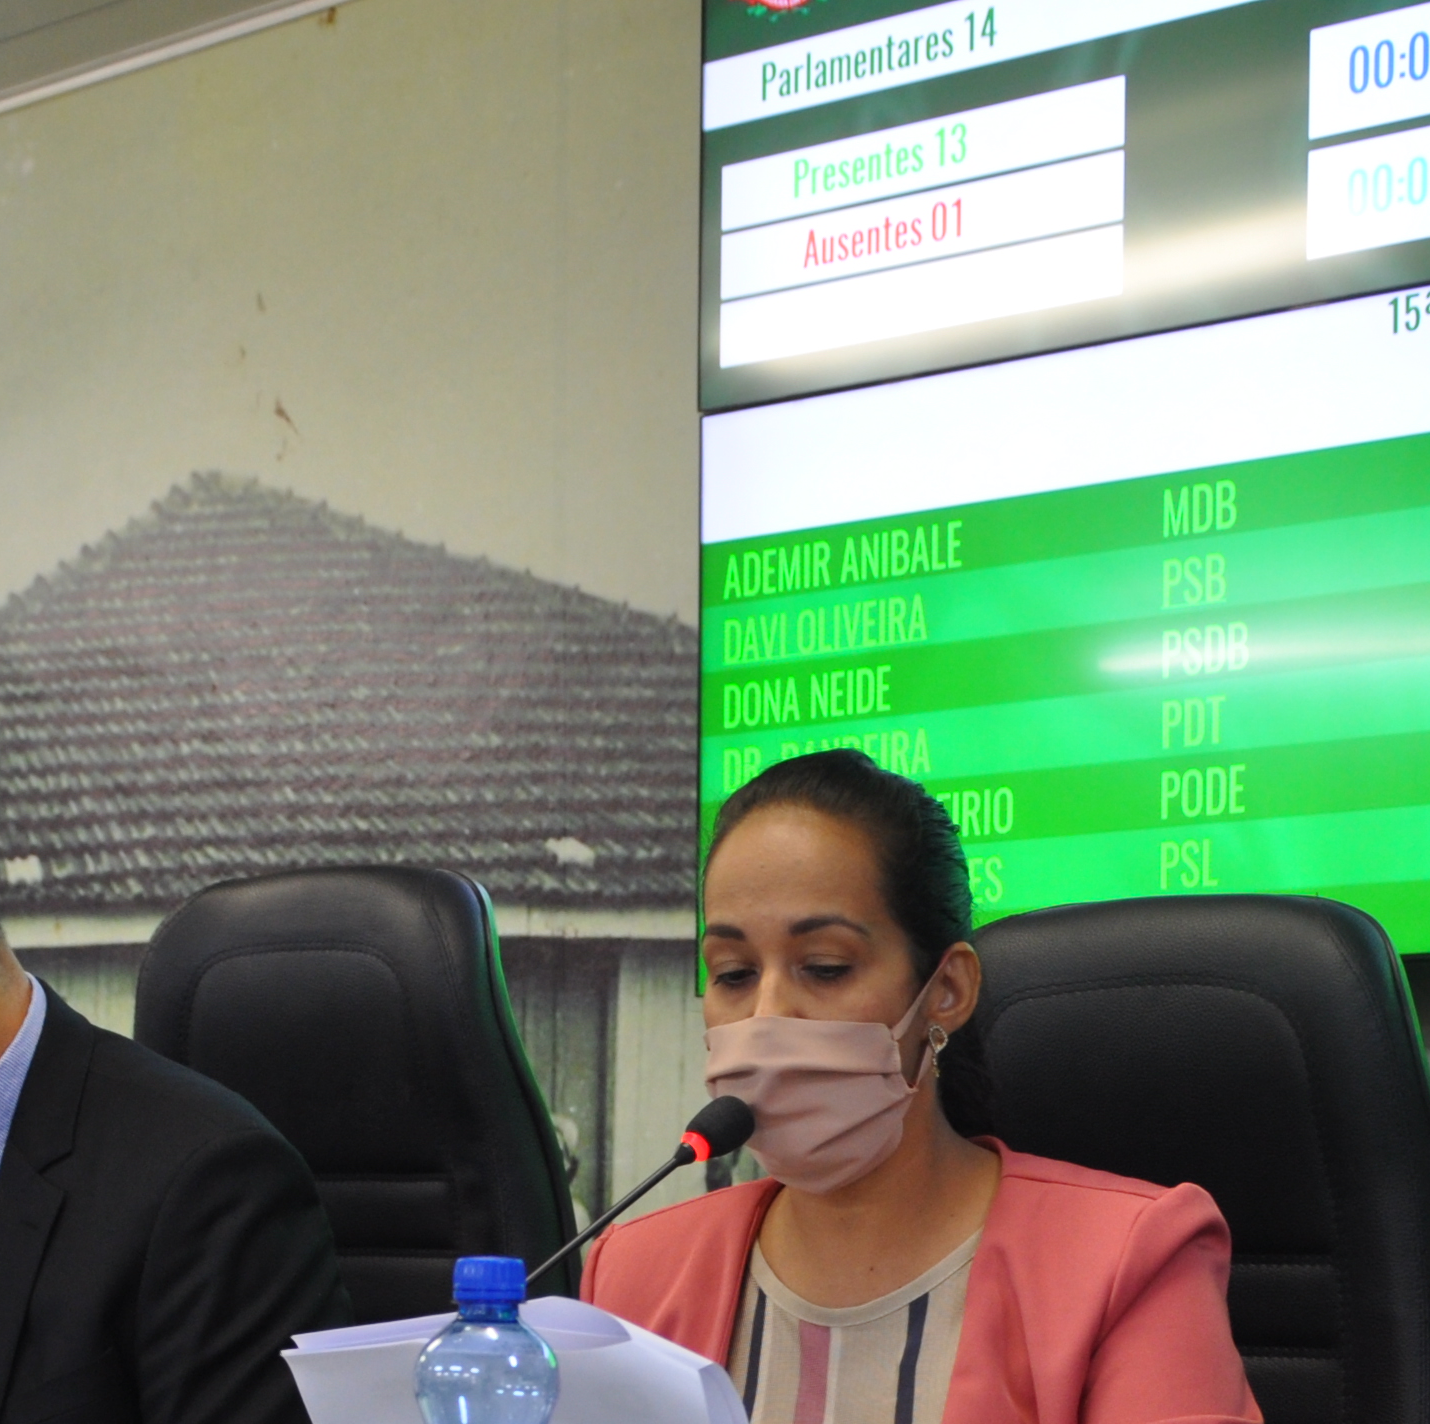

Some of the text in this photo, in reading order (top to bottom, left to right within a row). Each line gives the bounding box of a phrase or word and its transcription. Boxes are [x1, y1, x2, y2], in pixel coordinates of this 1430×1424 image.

[761, 7, 997, 101] Parlamentares 14
[793, 123, 968, 199] Presentes 13
[803, 198, 963, 269] Ausentes 01
[1162, 479, 1237, 538] MDB
[723, 519, 963, 600] ADEMIR ANIBALE
[1161, 553, 1228, 609] PSB
[723, 594, 928, 666] DAVI OLIVEIRA
[1161, 621, 1250, 679] PSDB
[723, 665, 891, 729] DONA NEIDE
[1161, 695, 1226, 751] PDT
[1160, 763, 1246, 822] PODE
[1160, 839, 1219, 891] PSL
